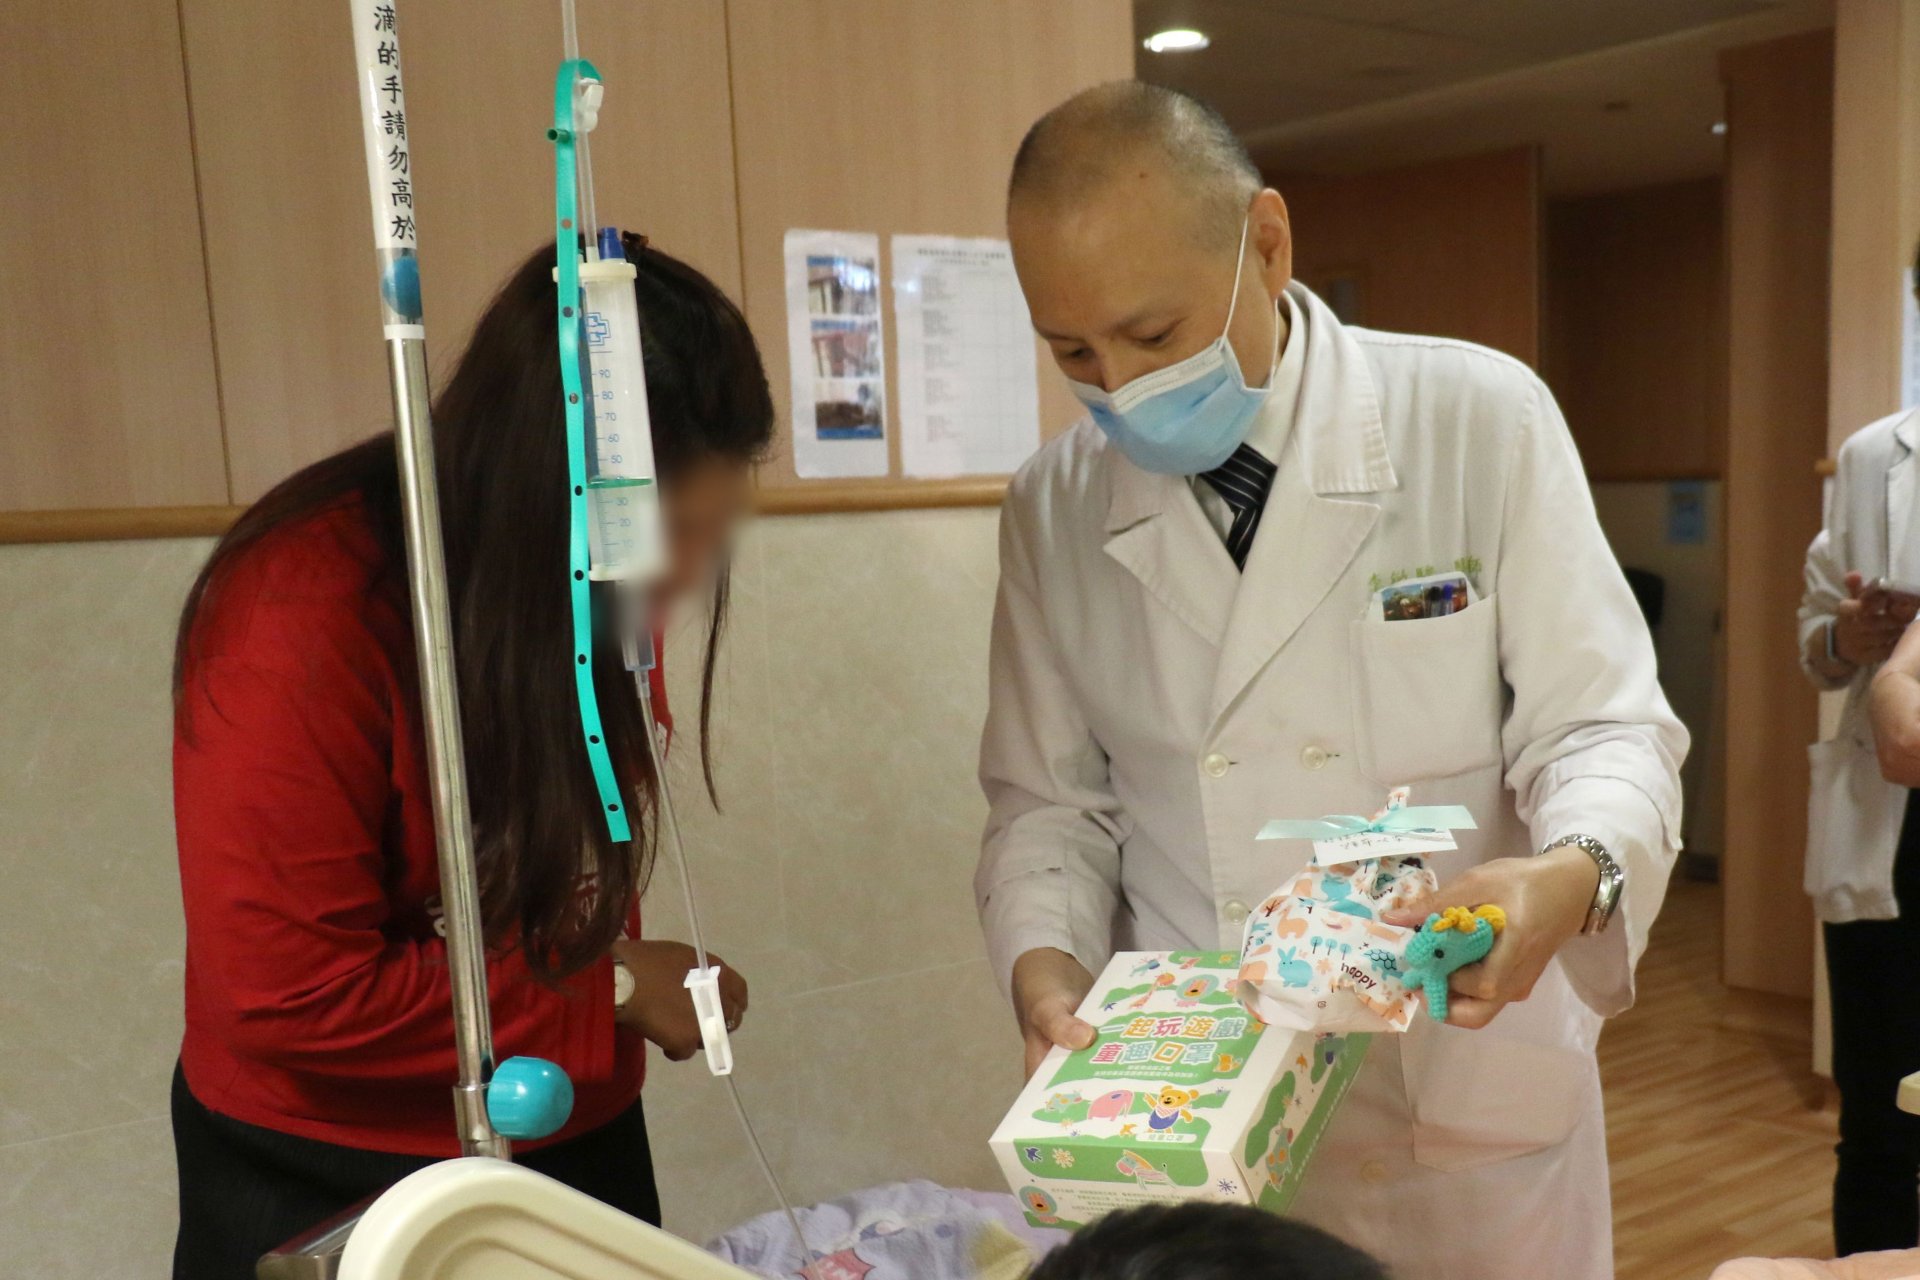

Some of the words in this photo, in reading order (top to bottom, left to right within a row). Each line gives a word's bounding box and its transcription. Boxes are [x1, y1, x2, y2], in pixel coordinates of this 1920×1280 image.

[373, 5, 416, 241] 滴的手請勿高於
[599, 369, 611, 378] 90
[602, 391, 614, 400] 80
[605, 412, 617, 421] 70
[607, 434, 620, 443] 60
[611, 455, 623, 464] 50
[1341, 962, 1377, 989] happy
[1098, 1015, 1247, 1040] 一起玩遊戲
[1089, 1040, 1218, 1065] 童趣口罩
